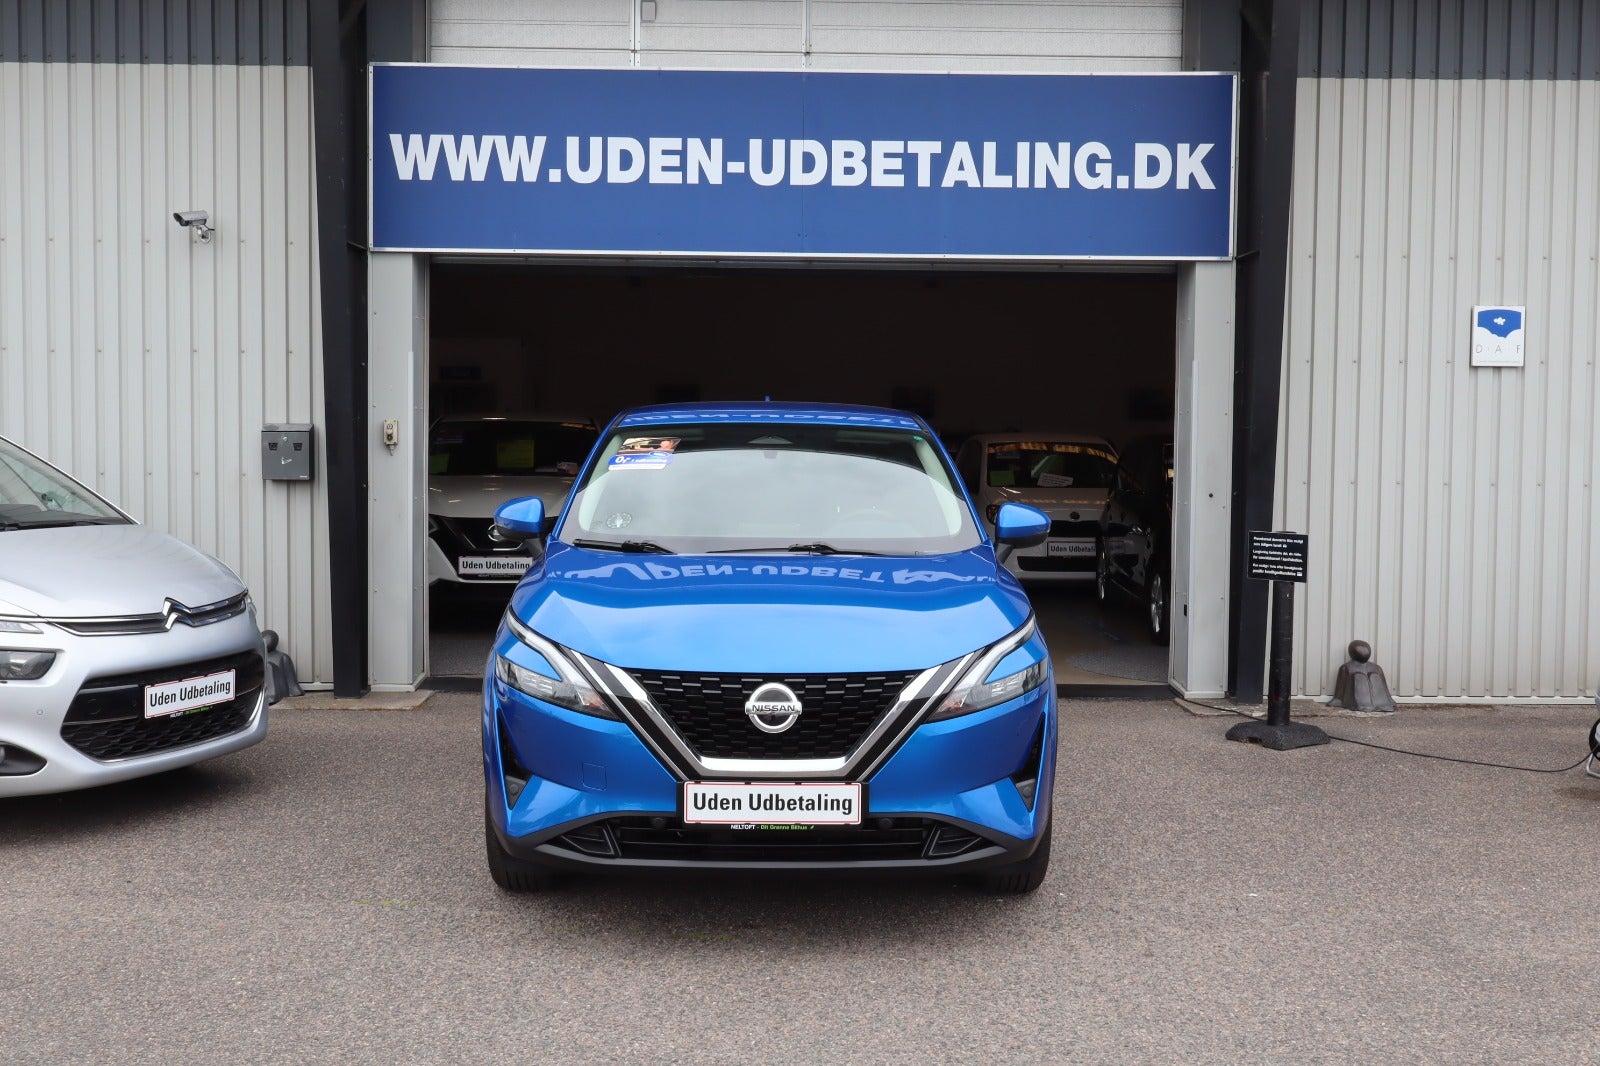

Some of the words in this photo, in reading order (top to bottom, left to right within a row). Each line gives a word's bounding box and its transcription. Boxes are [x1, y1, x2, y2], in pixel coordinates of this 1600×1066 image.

[388, 132, 1217, 192] WWW.UDEN-UDBETALING.DK
[1050, 545, 1067, 553] Uden
[462, 560, 483, 569] Uden
[149, 691, 177, 708] Uden
[179, 680, 231, 702] Udbetaling
[693, 792, 742, 811] Uden
[748, 793, 853, 816] Udbetaling
